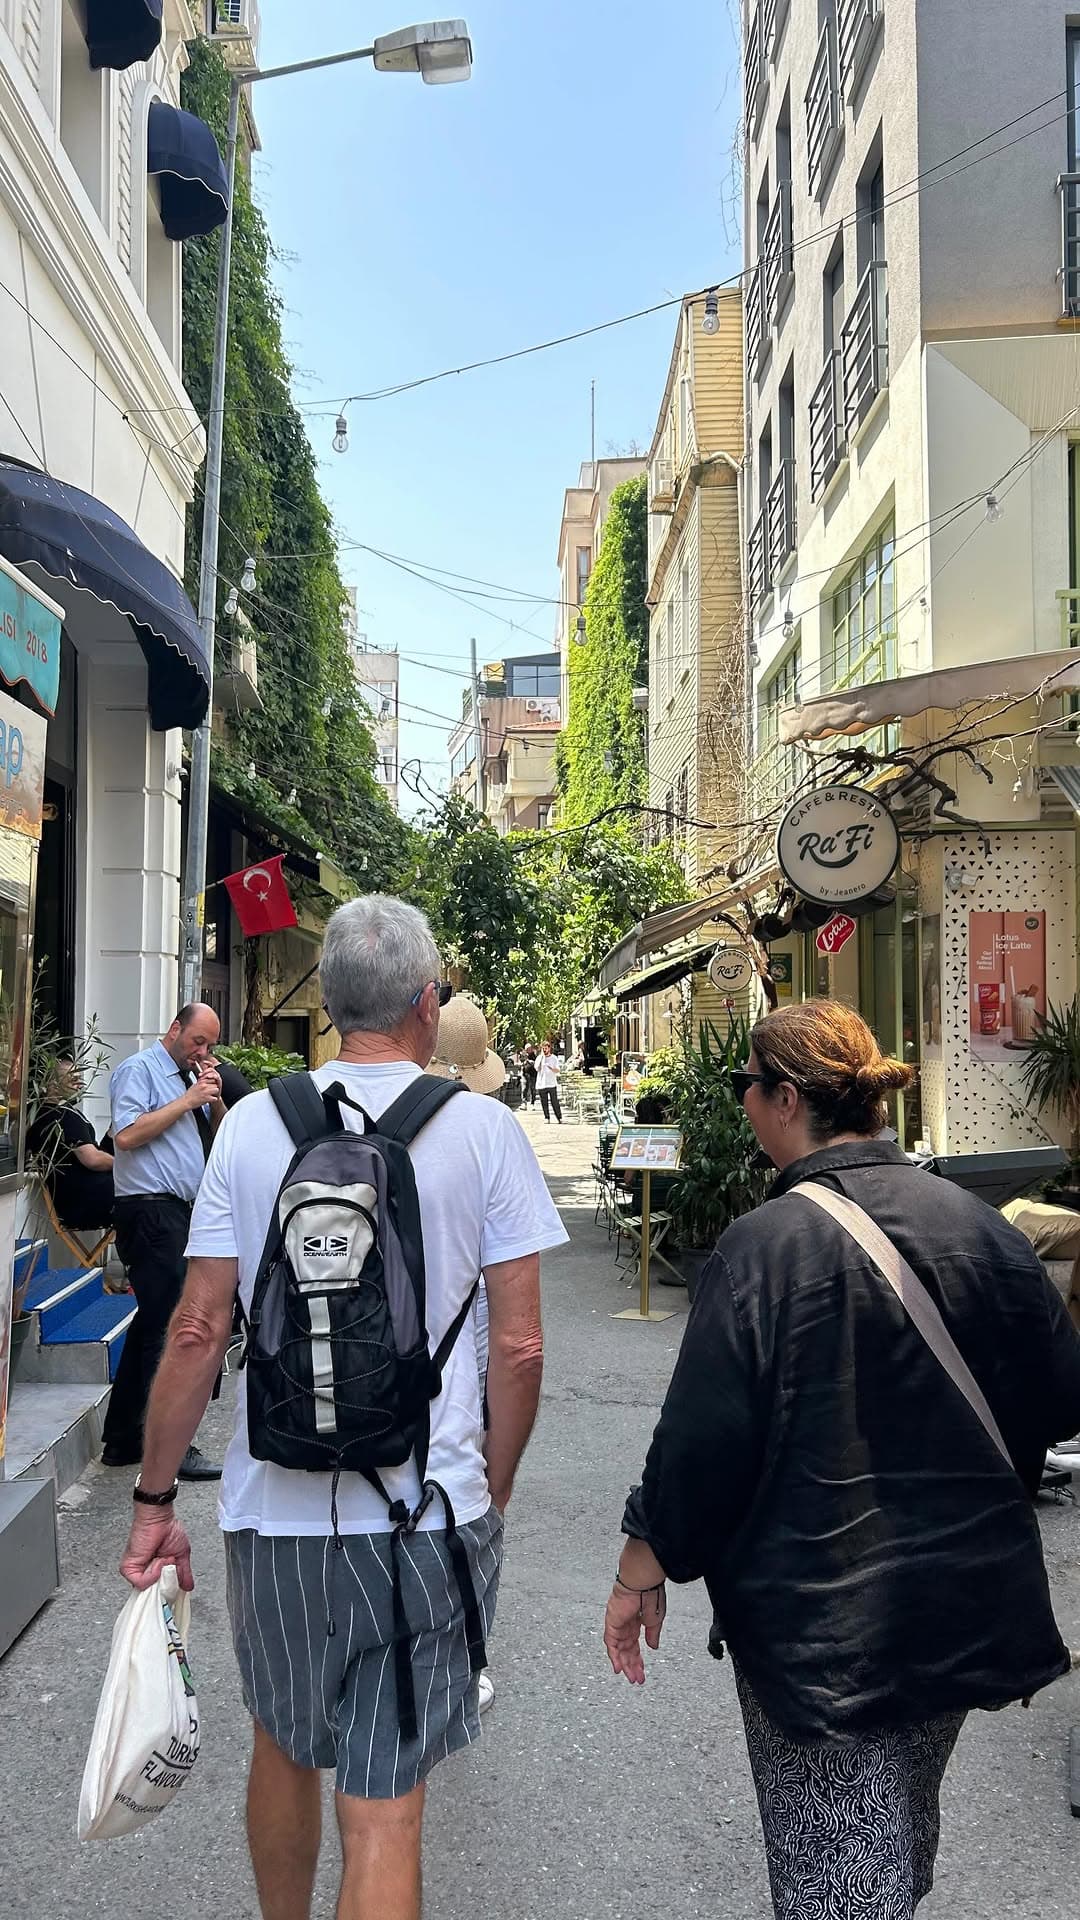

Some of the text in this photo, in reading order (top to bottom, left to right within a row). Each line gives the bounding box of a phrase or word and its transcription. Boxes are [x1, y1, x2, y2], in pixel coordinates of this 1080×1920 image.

[26, 630, 48, 664] 2018
[790, 791, 881, 827] CAFÉ & RESTO
[821, 918, 848, 951] Lotus
[995, 933, 1020, 941] Lotus
